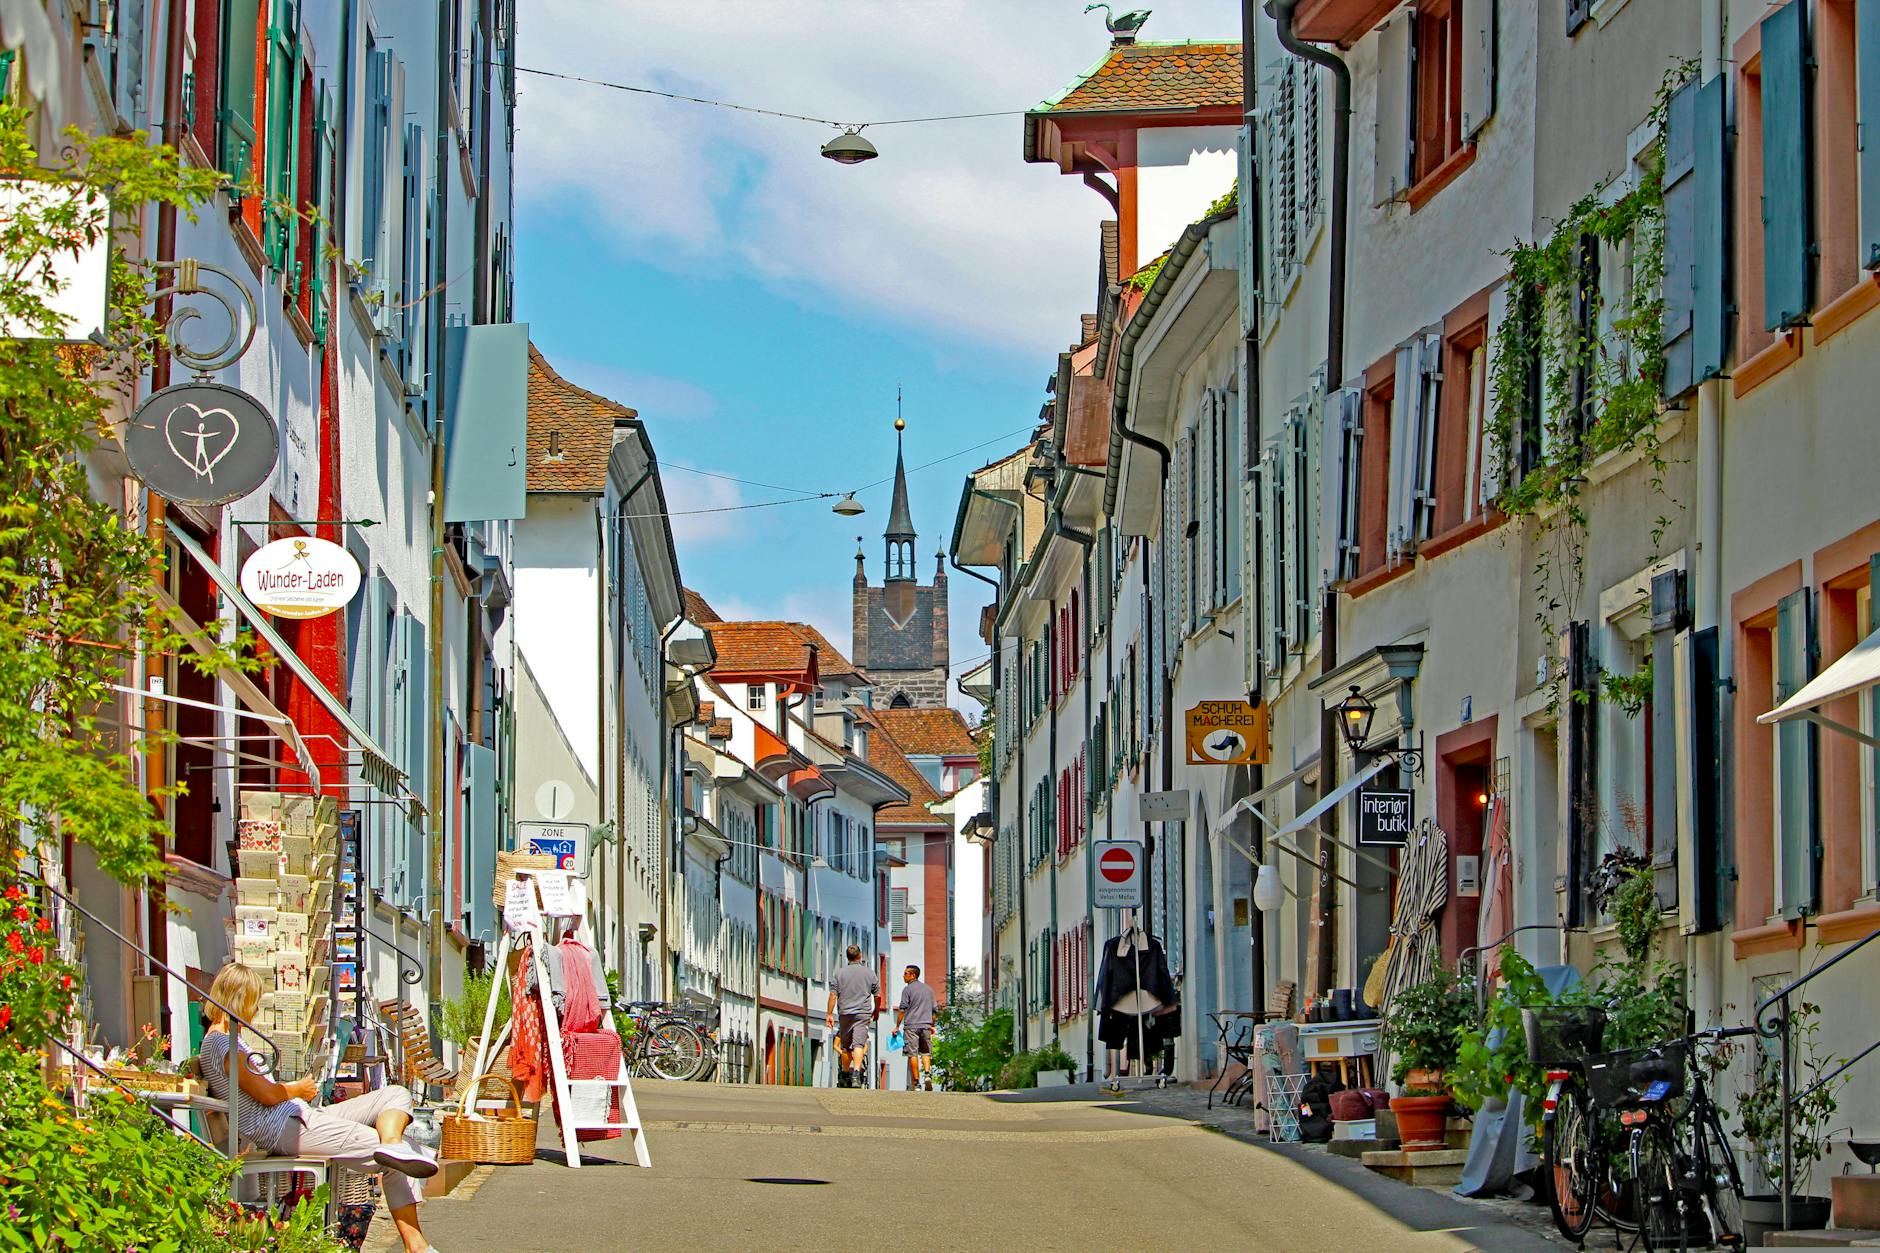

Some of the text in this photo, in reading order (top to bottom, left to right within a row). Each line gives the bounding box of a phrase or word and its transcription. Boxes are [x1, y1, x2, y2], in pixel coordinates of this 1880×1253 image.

[257, 570, 344, 591] Wunder-Laden
[1201, 703, 1242, 715] SCHUH
[1193, 715, 1254, 726] MACHEREI
[1364, 796, 1407, 815] interiør
[1377, 813, 1407, 832] butik
[541, 828, 564, 837] ZONE
[565, 859, 574, 868] 20
